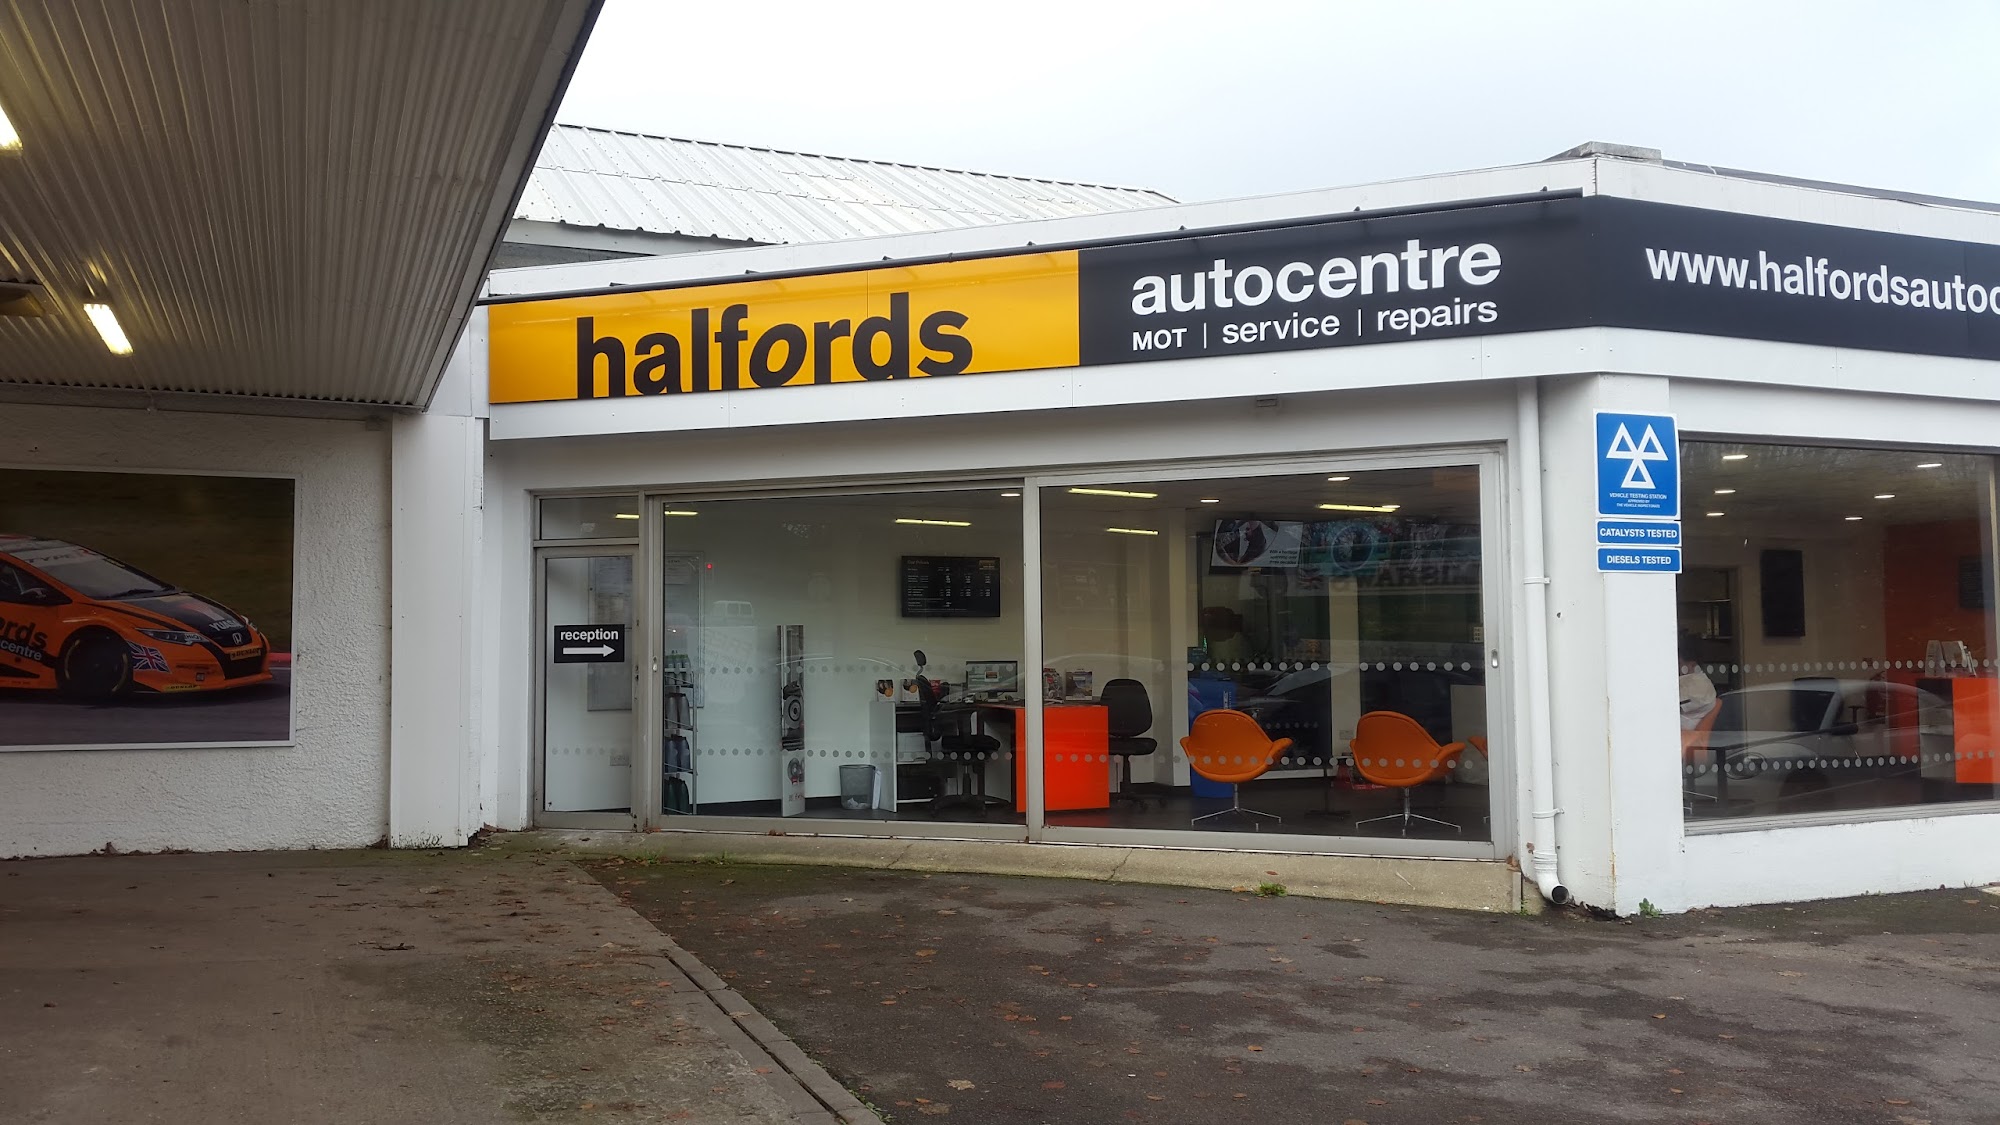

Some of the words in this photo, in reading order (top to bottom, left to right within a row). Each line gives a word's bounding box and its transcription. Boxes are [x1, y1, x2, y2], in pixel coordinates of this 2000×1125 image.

[1131, 239, 1502, 316] autocentre
[1132, 328, 1188, 351] MOT
[1222, 311, 1340, 344] service
[1377, 297, 1498, 335] repairs
[577, 292, 973, 399] halfords
[1600, 528, 1645, 537] CATALYSTS
[1647, 529, 1677, 538] TESTED
[1607, 555, 1640, 564] DIESELS
[1642, 556, 1672, 564] TESTED
[560, 628, 619, 643] reception
[0, 640, 42, 660] centre
